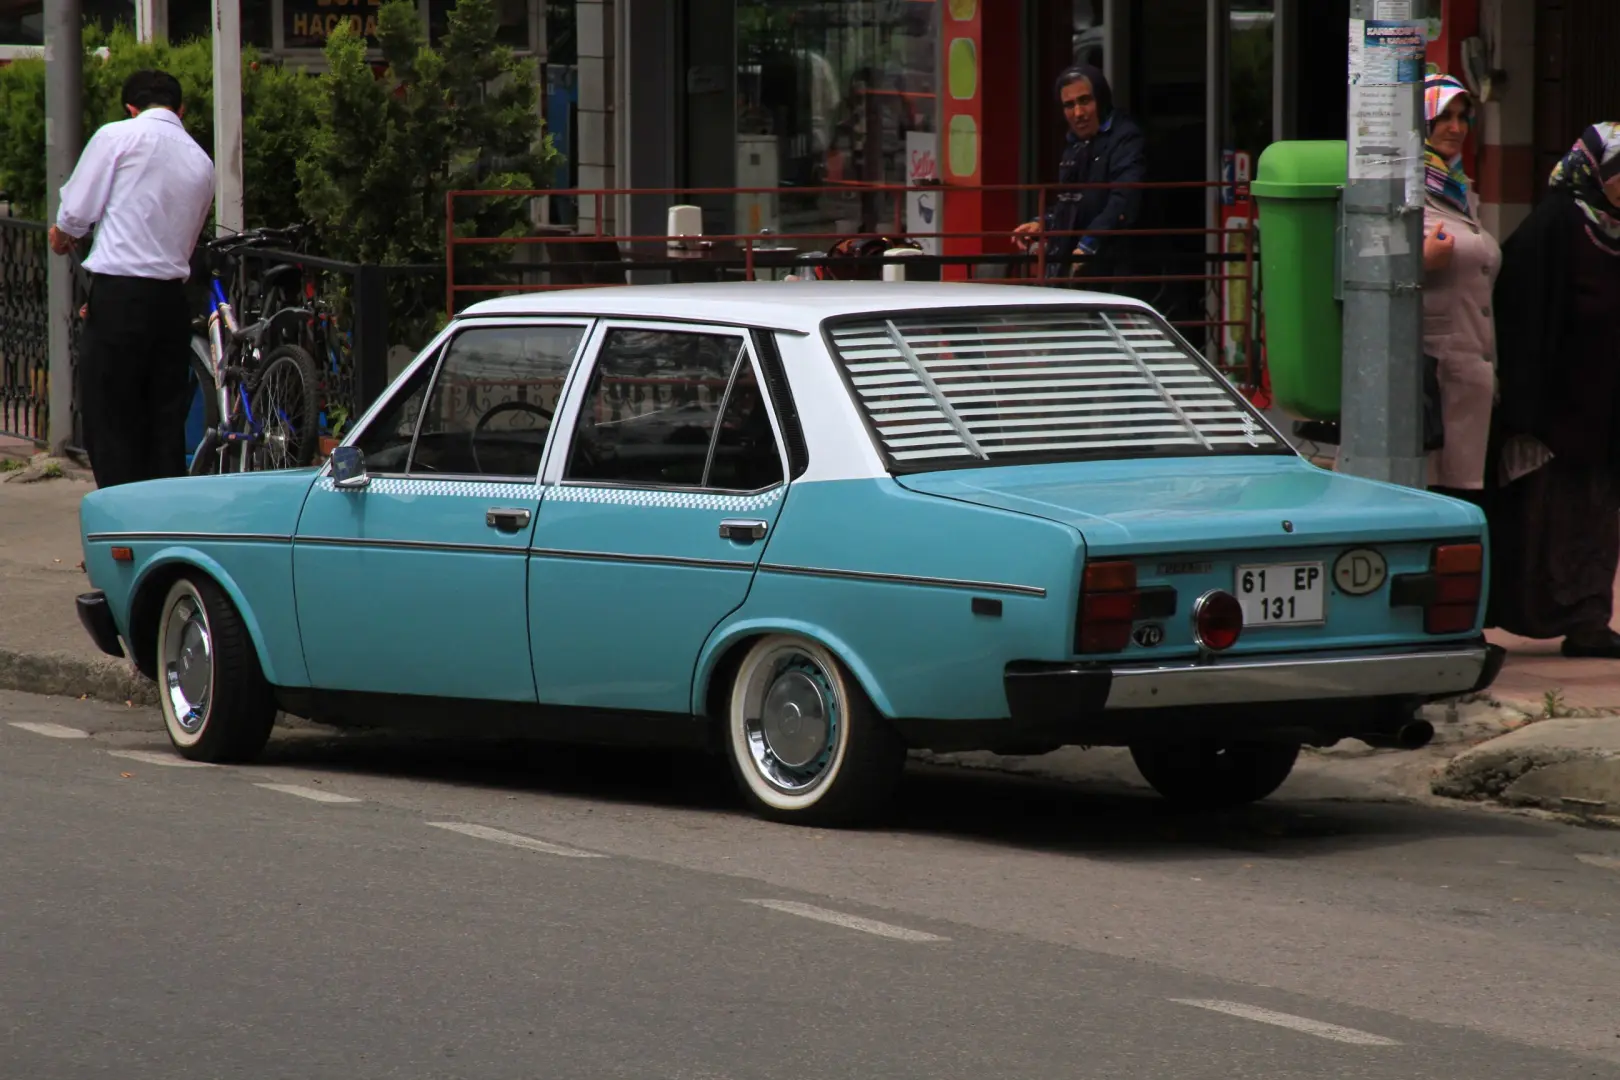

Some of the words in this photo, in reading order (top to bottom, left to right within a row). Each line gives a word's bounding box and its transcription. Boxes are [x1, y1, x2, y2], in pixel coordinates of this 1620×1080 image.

[1242, 570, 1266, 594] 61
[1294, 567, 1319, 591] EP
[1352, 556, 1372, 588] D
[1261, 596, 1296, 620] 131
